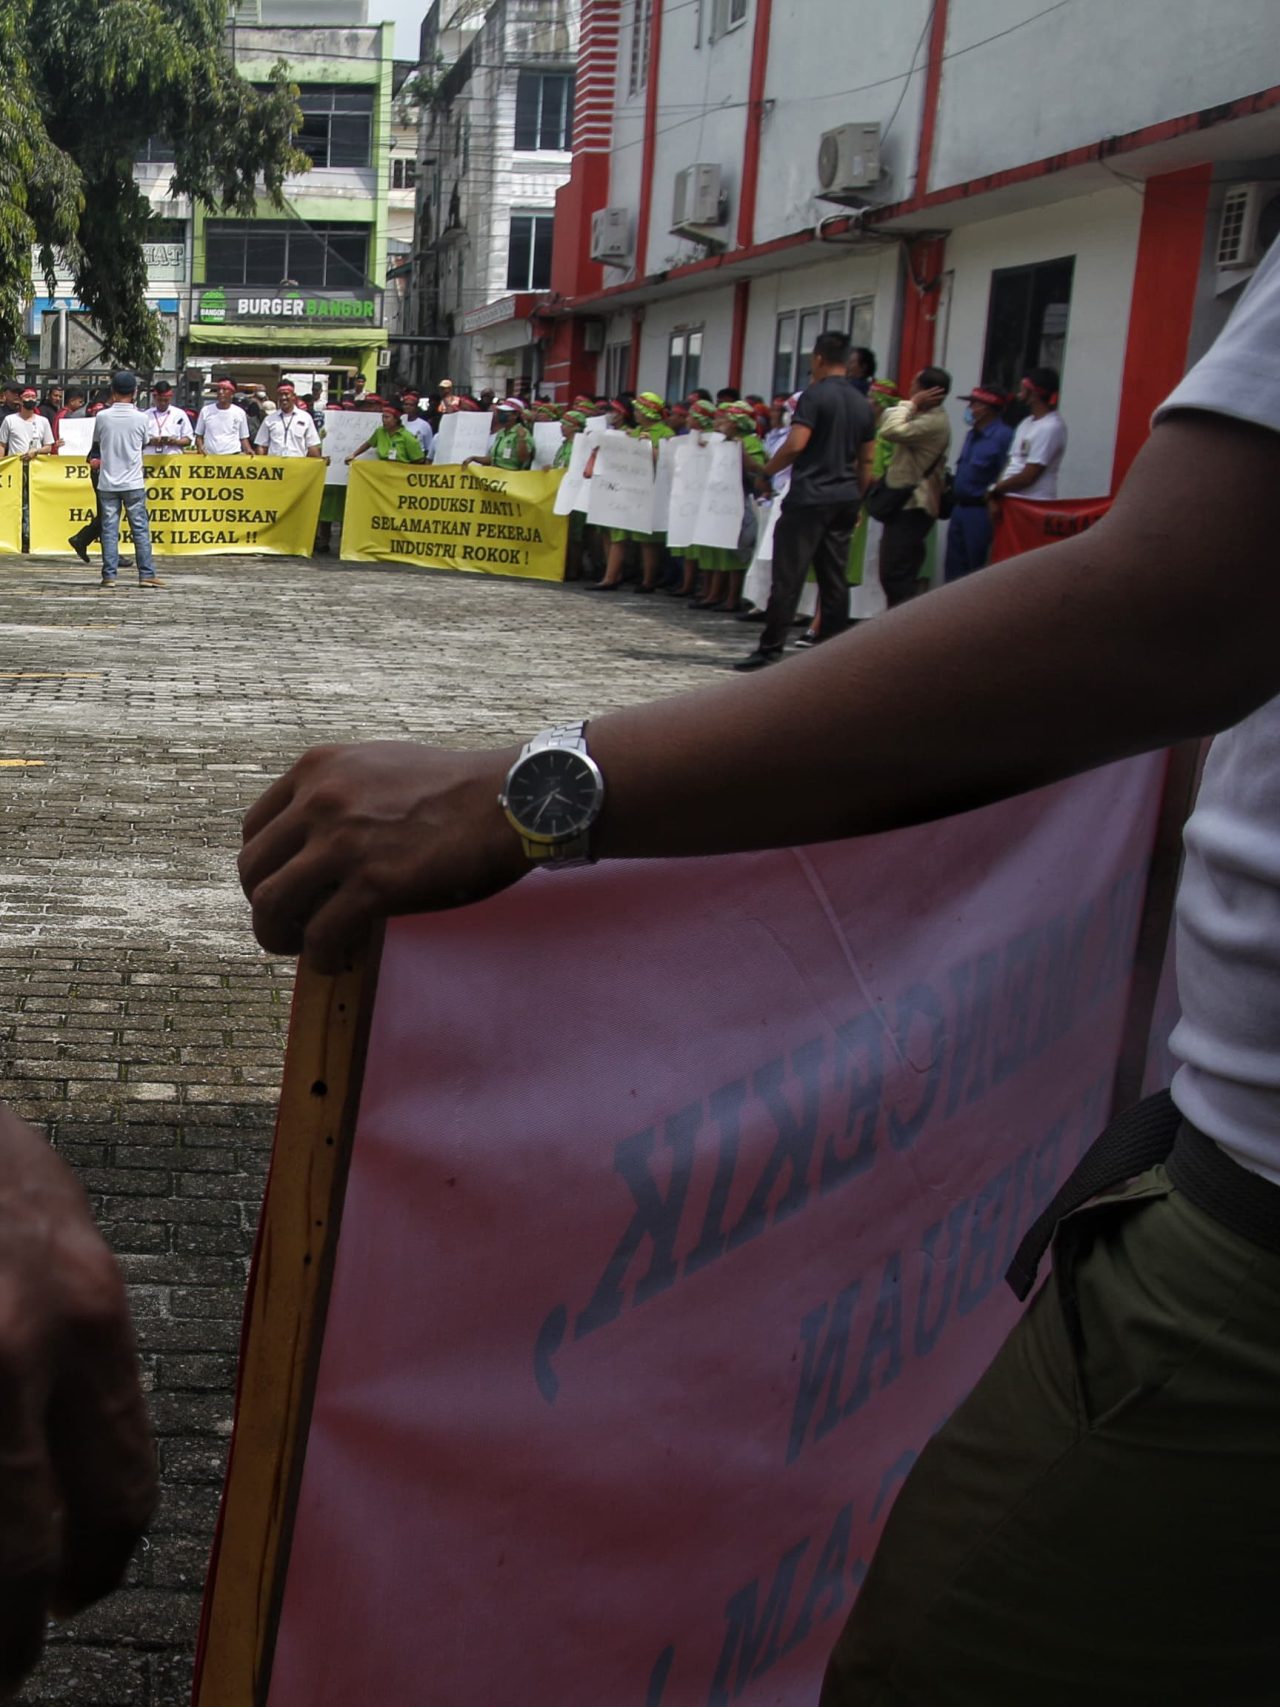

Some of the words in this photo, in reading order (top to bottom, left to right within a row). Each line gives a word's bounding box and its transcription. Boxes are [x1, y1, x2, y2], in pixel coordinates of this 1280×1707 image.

[200, 308, 225, 316] BANGOR
[237, 298, 304, 316] BURGER
[306, 300, 374, 317] BANGOR
[189, 465, 284, 481] KEMASAN
[407, 473, 455, 489] CUKAI
[181, 487, 244, 501] POLOS
[397, 495, 474, 513] PRODUKSI
[480, 499, 514, 517] MATI
[147, 508, 278, 523] MEMULUSKAN
[170, 530, 240, 545] ILEGAL
[246, 530, 258, 544] !!
[371, 516, 471, 537] SELAMATKAN
[476, 522, 543, 543] PEKERJA
[390, 539, 456, 559] INDUSTRI
[462, 545, 520, 565] ROKOK
